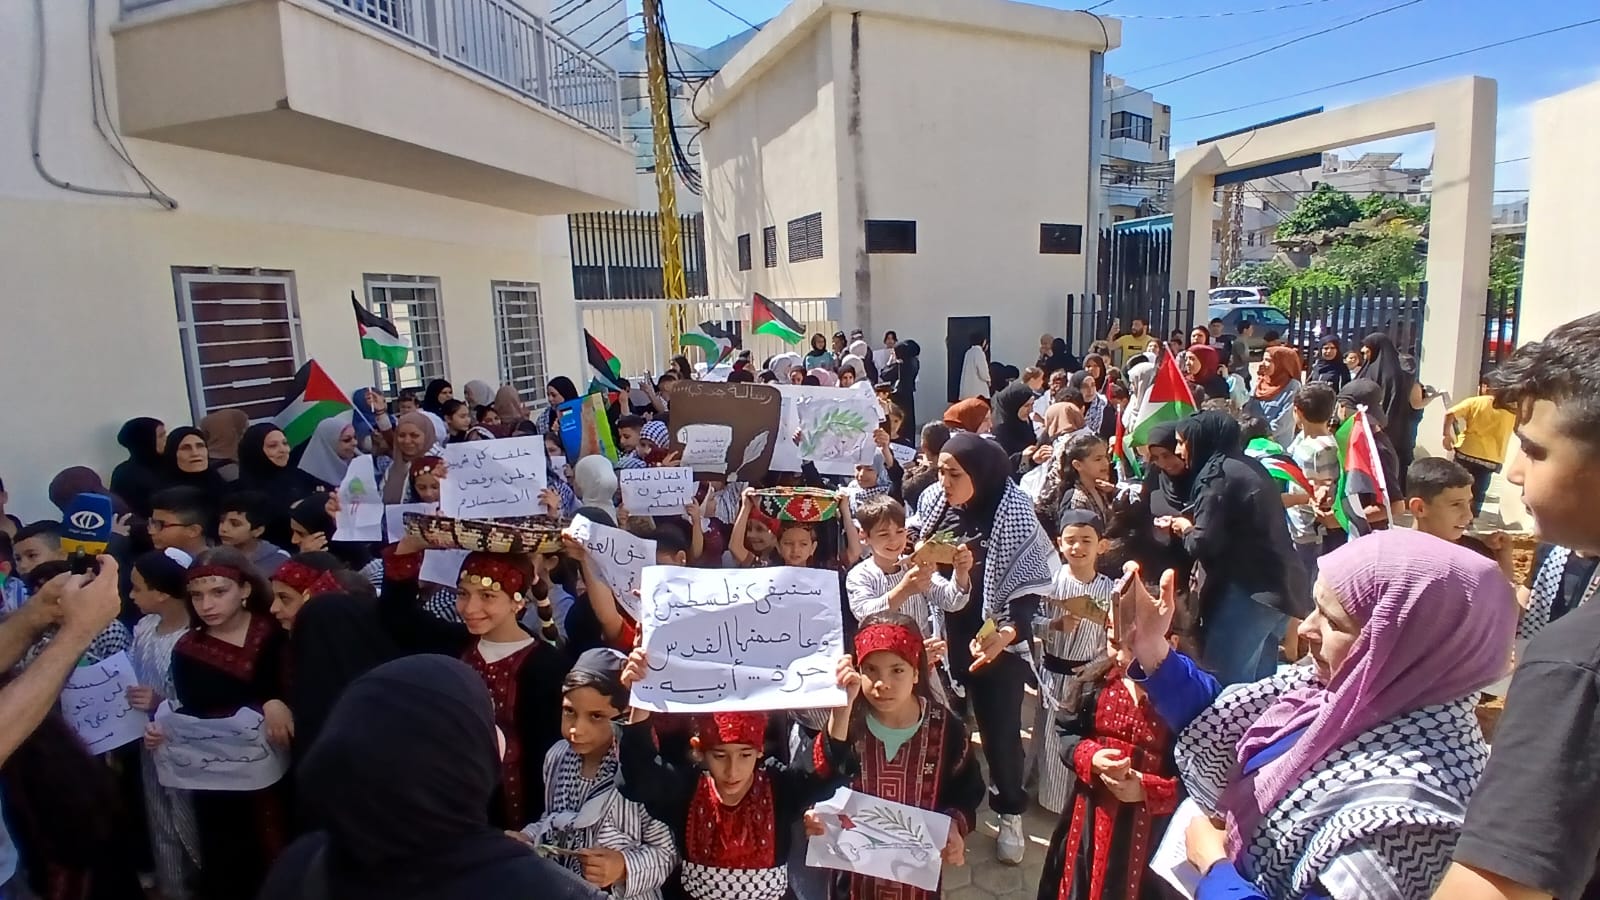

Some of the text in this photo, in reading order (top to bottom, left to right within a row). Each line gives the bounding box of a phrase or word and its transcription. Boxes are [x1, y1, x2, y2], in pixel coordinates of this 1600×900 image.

[473, 446, 489, 469] كل
[492, 447, 531, 460] خلف
[501, 468, 536, 485] وطن
[457, 488, 530, 517] الاستسلام
[613, 544, 645, 565] حق
[653, 578, 740, 621] فلسطين
[647, 613, 829, 671] وعاصمتها القدس
[771, 664, 828, 692] حرة
